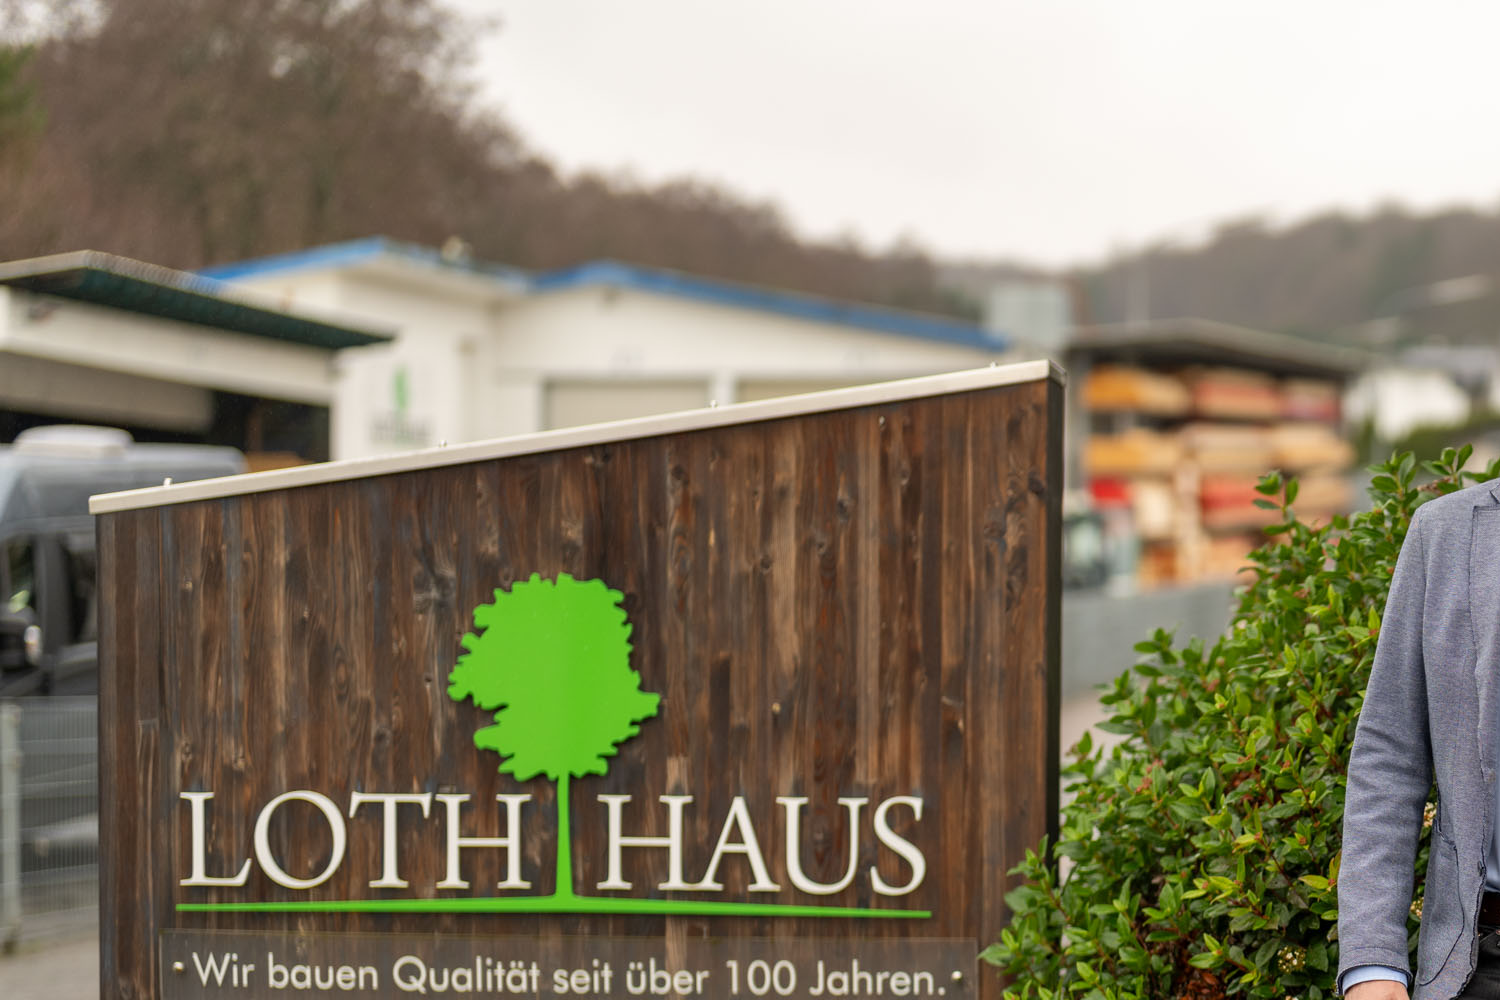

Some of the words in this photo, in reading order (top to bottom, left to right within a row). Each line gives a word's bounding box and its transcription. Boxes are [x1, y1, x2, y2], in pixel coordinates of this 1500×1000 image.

[179, 790, 532, 890] LOTH
[597, 794, 926, 896] HAUS
[192, 951, 255, 987] Wir
[268, 952, 378, 990] bauen
[392, 955, 540, 994] Qualität
[553, 958, 613, 994] seit
[626, 957, 709, 995] über
[726, 960, 796, 996] 100
[809, 958, 946, 996] Jahren.
